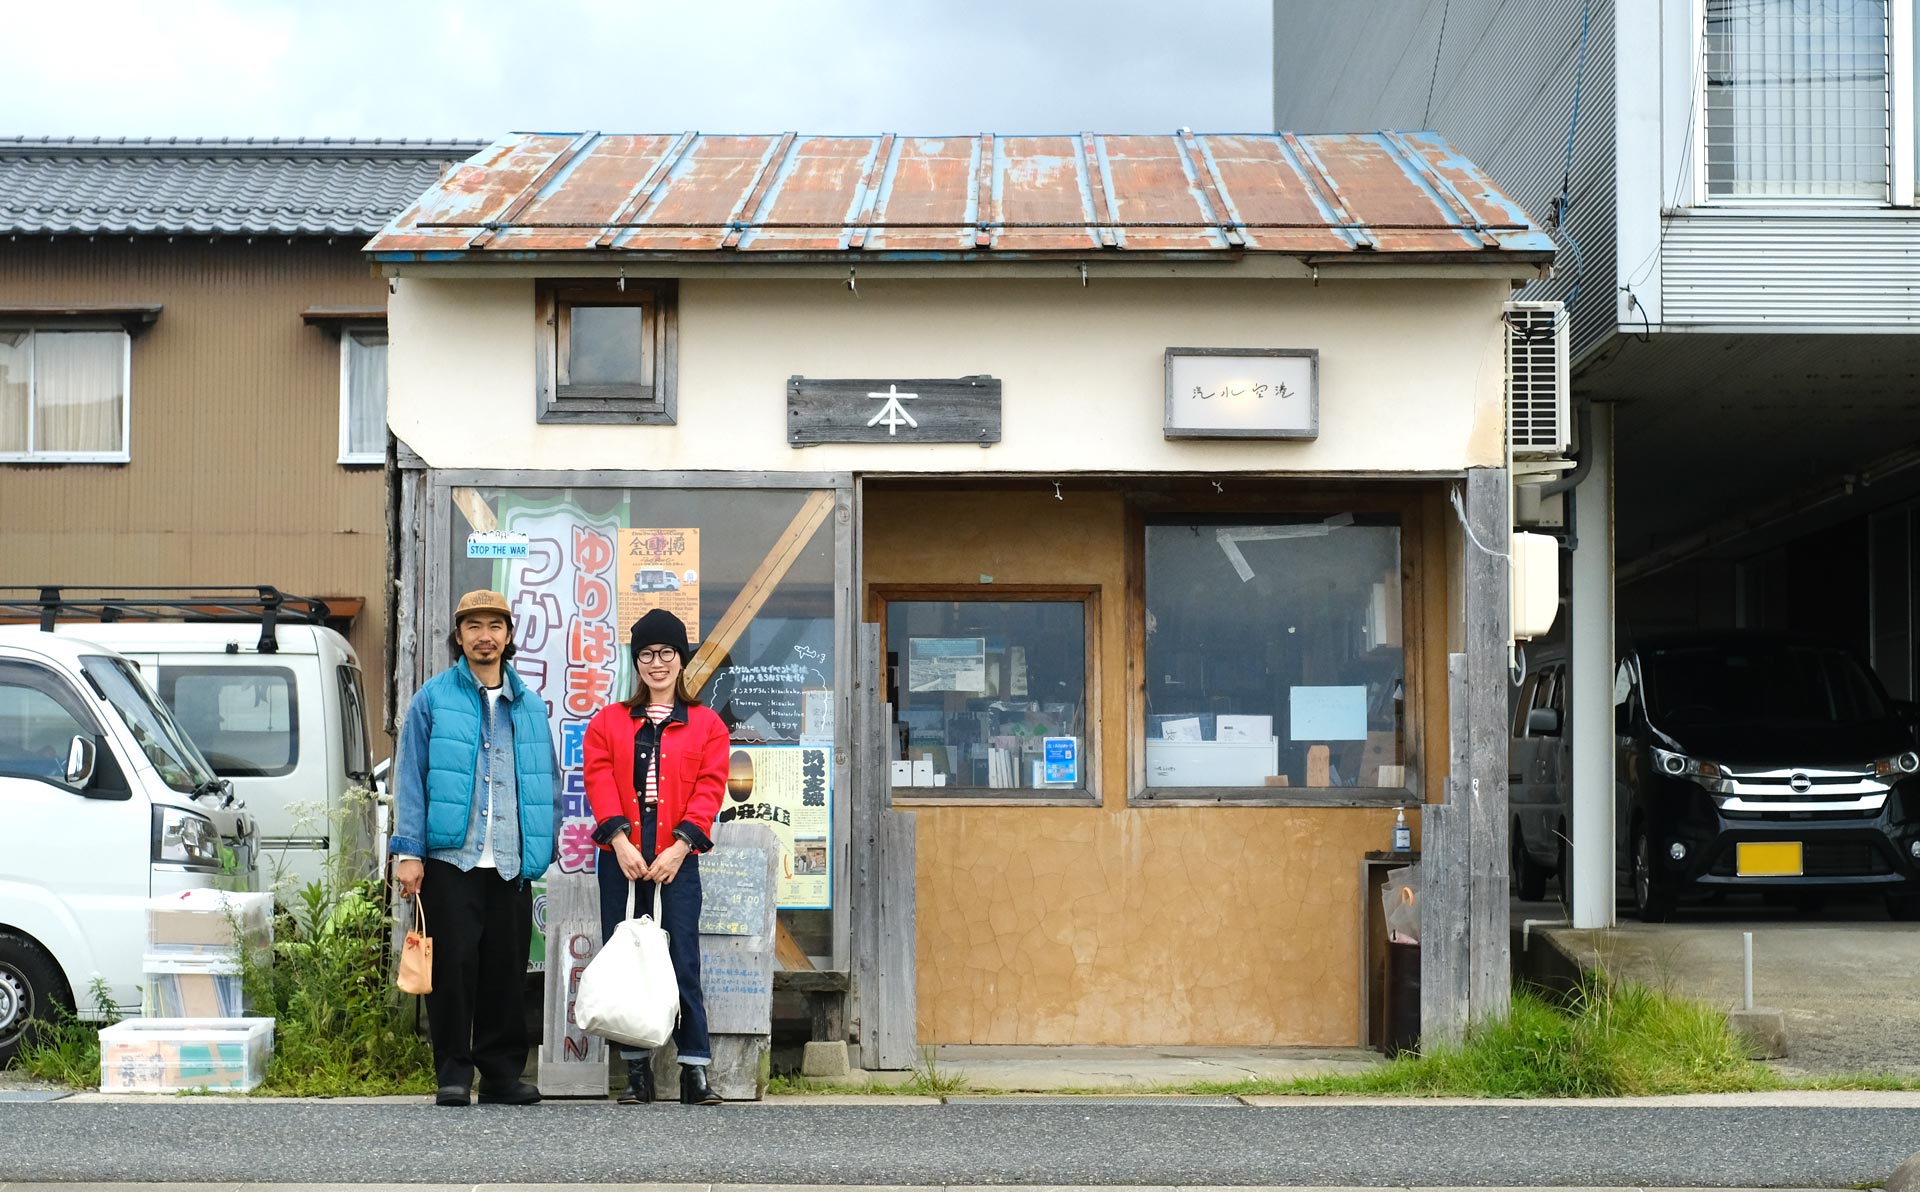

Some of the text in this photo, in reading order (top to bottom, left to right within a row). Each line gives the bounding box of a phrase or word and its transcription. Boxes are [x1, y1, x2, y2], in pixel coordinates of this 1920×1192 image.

[866, 383, 919, 436] 本
[470, 545, 526, 555] STOP THE WAR
